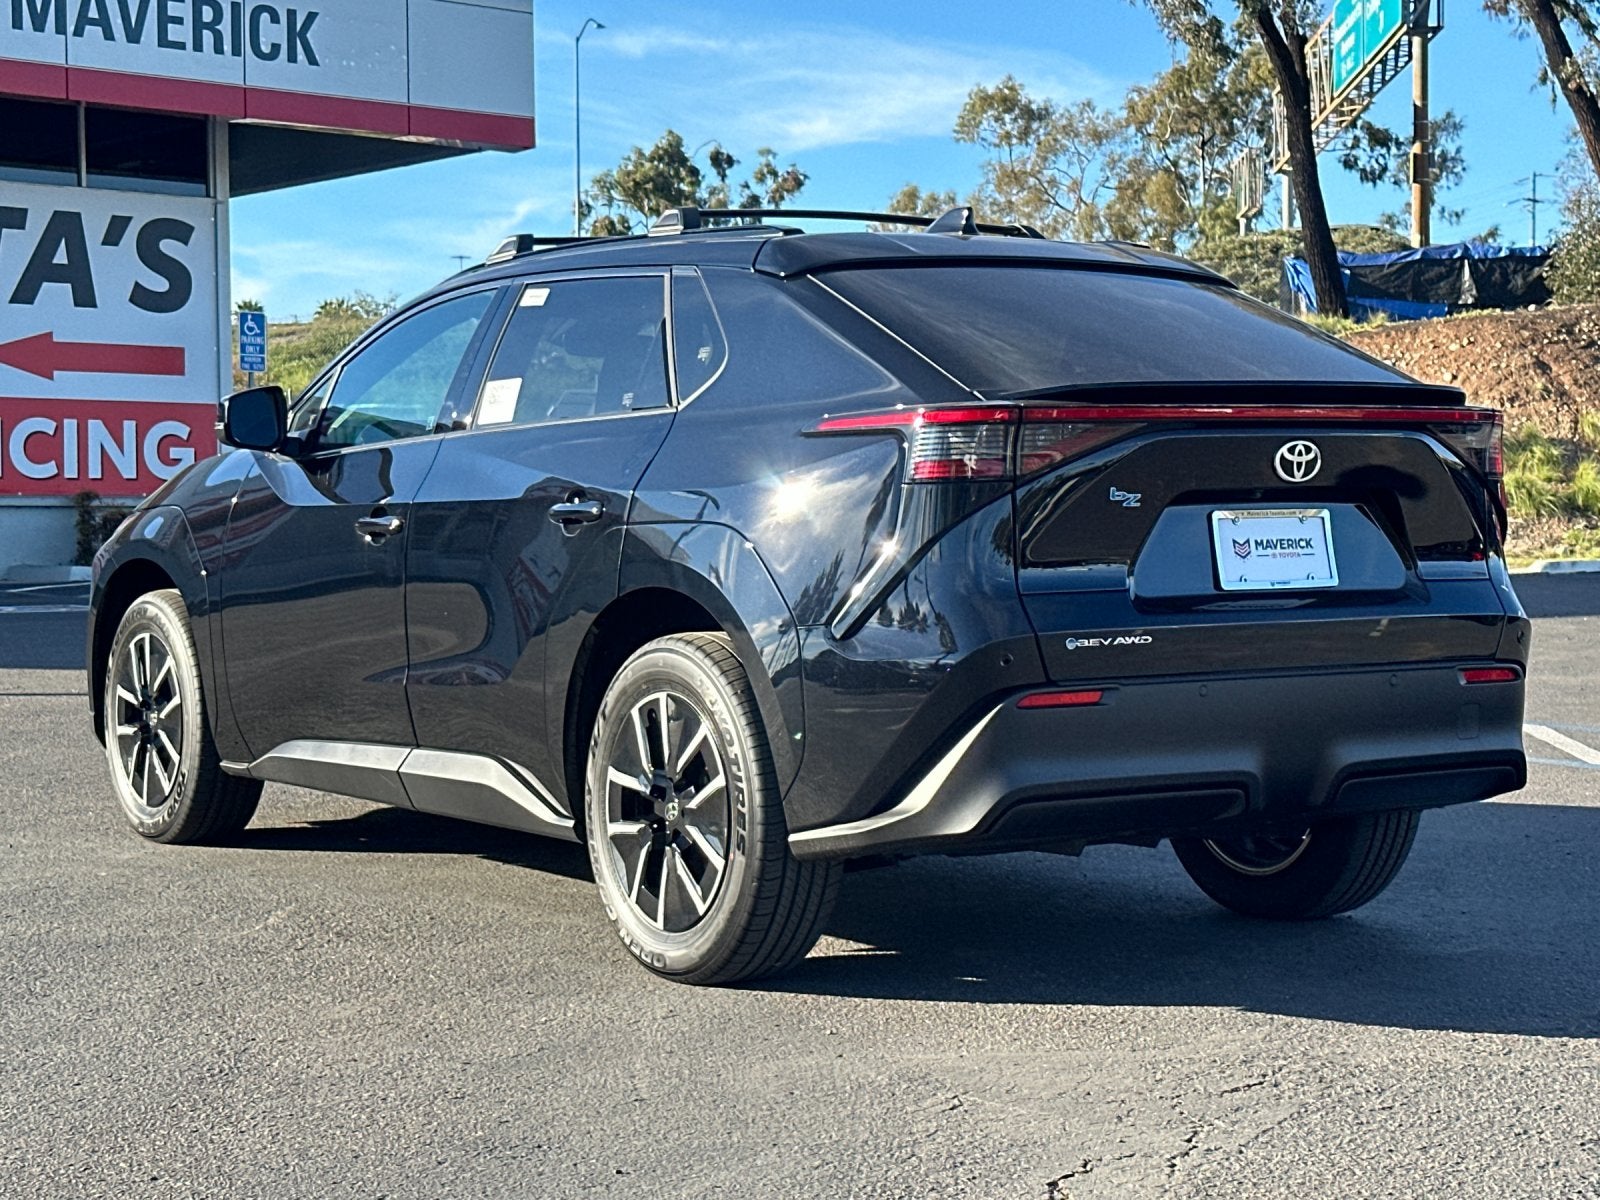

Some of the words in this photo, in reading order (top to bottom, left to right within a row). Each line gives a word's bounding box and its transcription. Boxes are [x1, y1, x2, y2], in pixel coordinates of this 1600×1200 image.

[11, 0, 320, 66] MAVERICK
[241, 336, 264, 344] PARKING
[245, 345, 260, 354] ONLY
[0, 417, 195, 481] CING
[1254, 538, 1314, 550] MAVERICK
[1113, 635, 1152, 645] AWD
[166, 769, 189, 820] TOYO
[728, 752, 747, 857] TIRES
